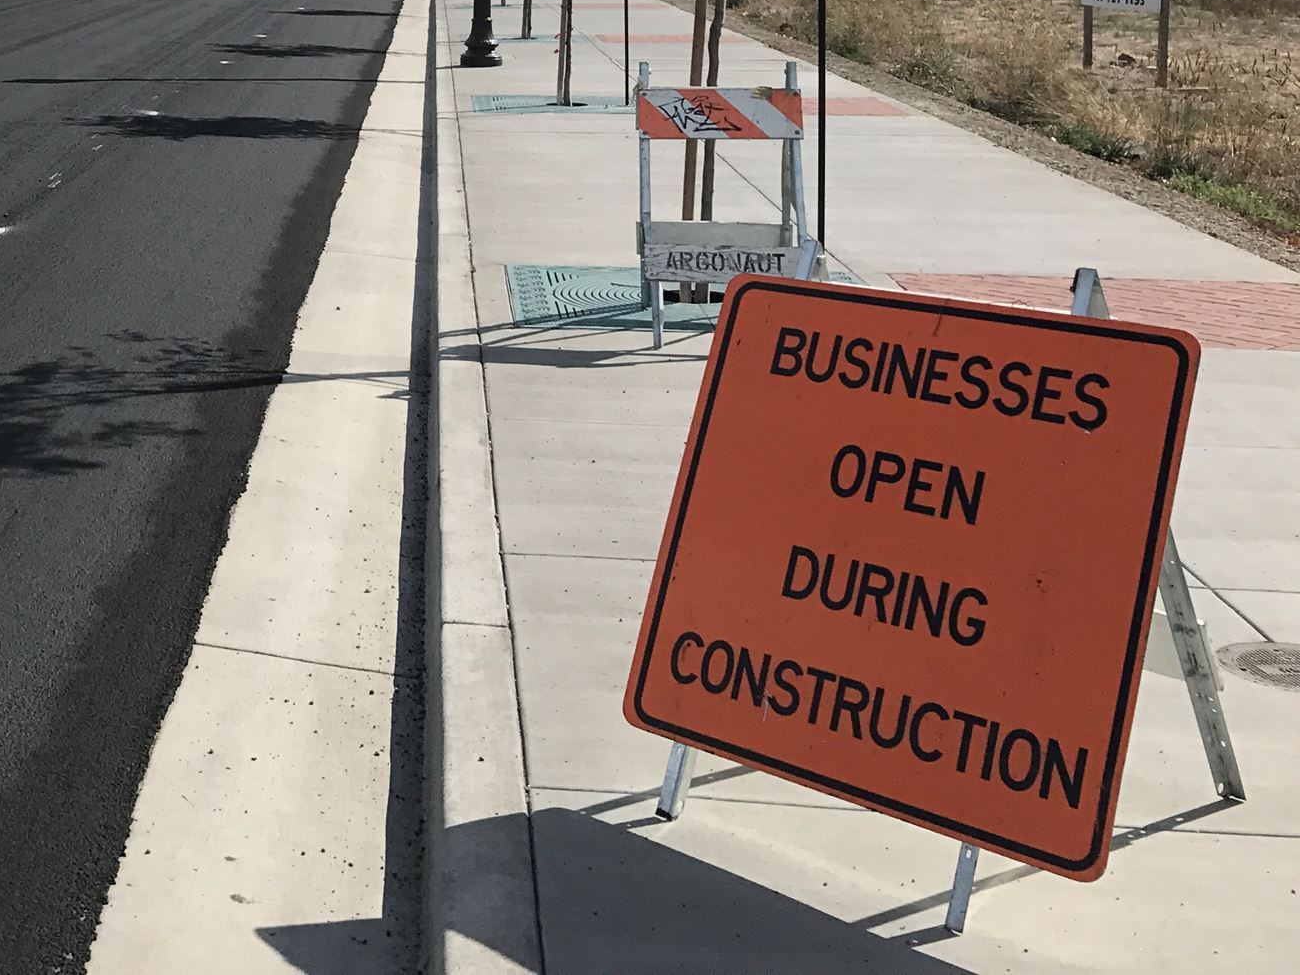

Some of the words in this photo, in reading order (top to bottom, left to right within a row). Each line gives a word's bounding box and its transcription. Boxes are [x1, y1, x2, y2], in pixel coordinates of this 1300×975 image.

[665, 251, 786, 274] ARGONAUT
[770, 327, 1111, 435] BUSINESSES
[830, 444, 986, 527] OPEN
[781, 545, 988, 647] DURING
[670, 631, 1089, 809] CONSTRUCTION
